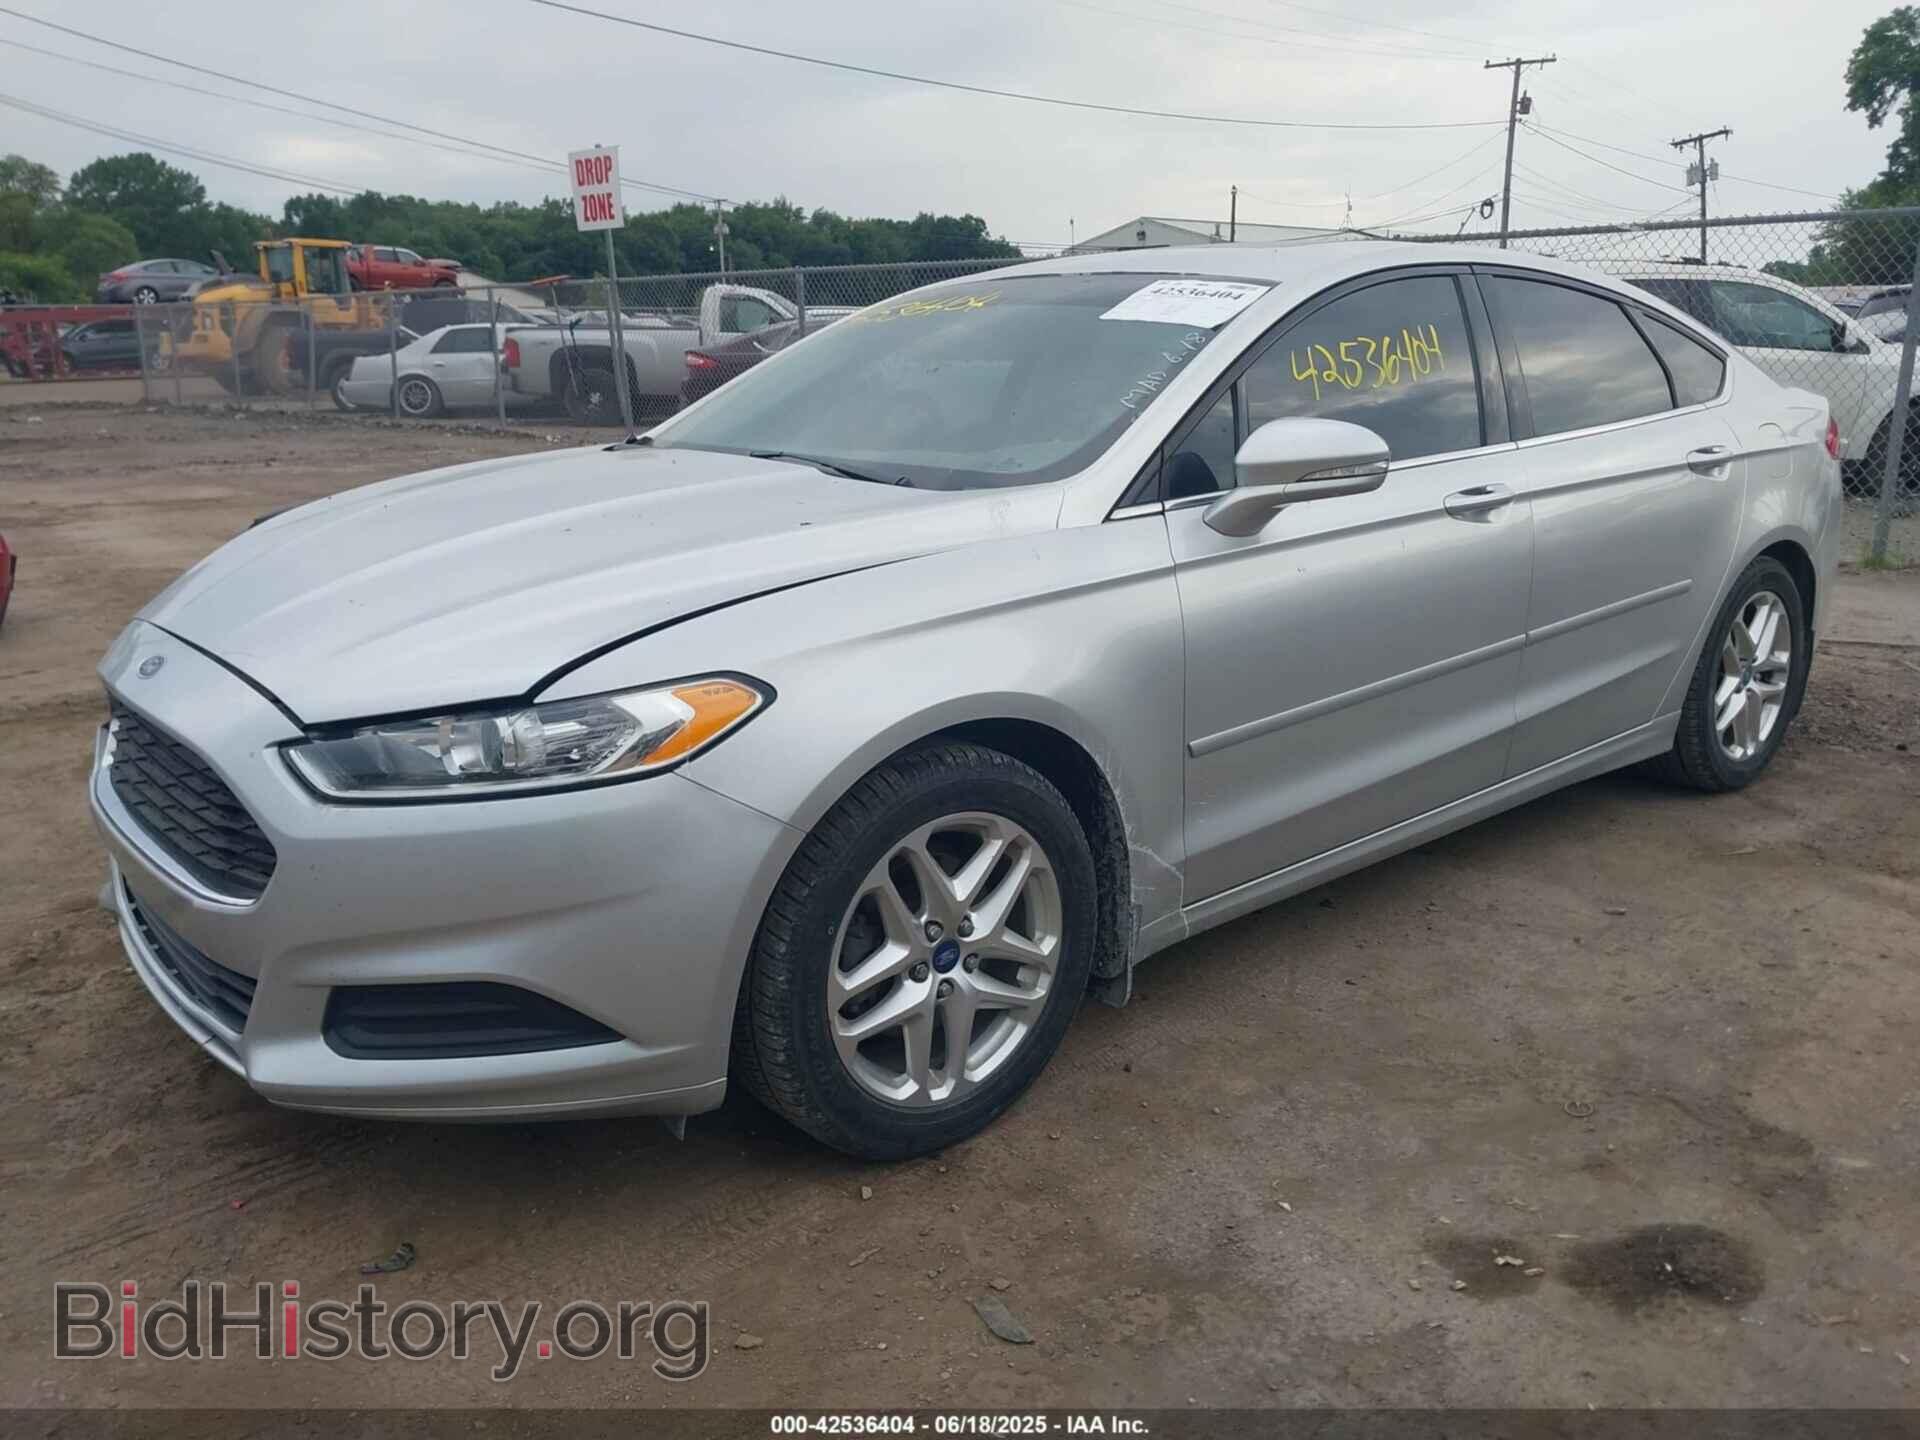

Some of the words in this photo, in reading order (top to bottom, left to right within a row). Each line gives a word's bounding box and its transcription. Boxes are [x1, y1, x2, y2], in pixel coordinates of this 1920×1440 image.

[575, 155, 612, 187] DROP
[581, 192, 615, 222] ZONE
[1291, 324, 1444, 400] 42536404
